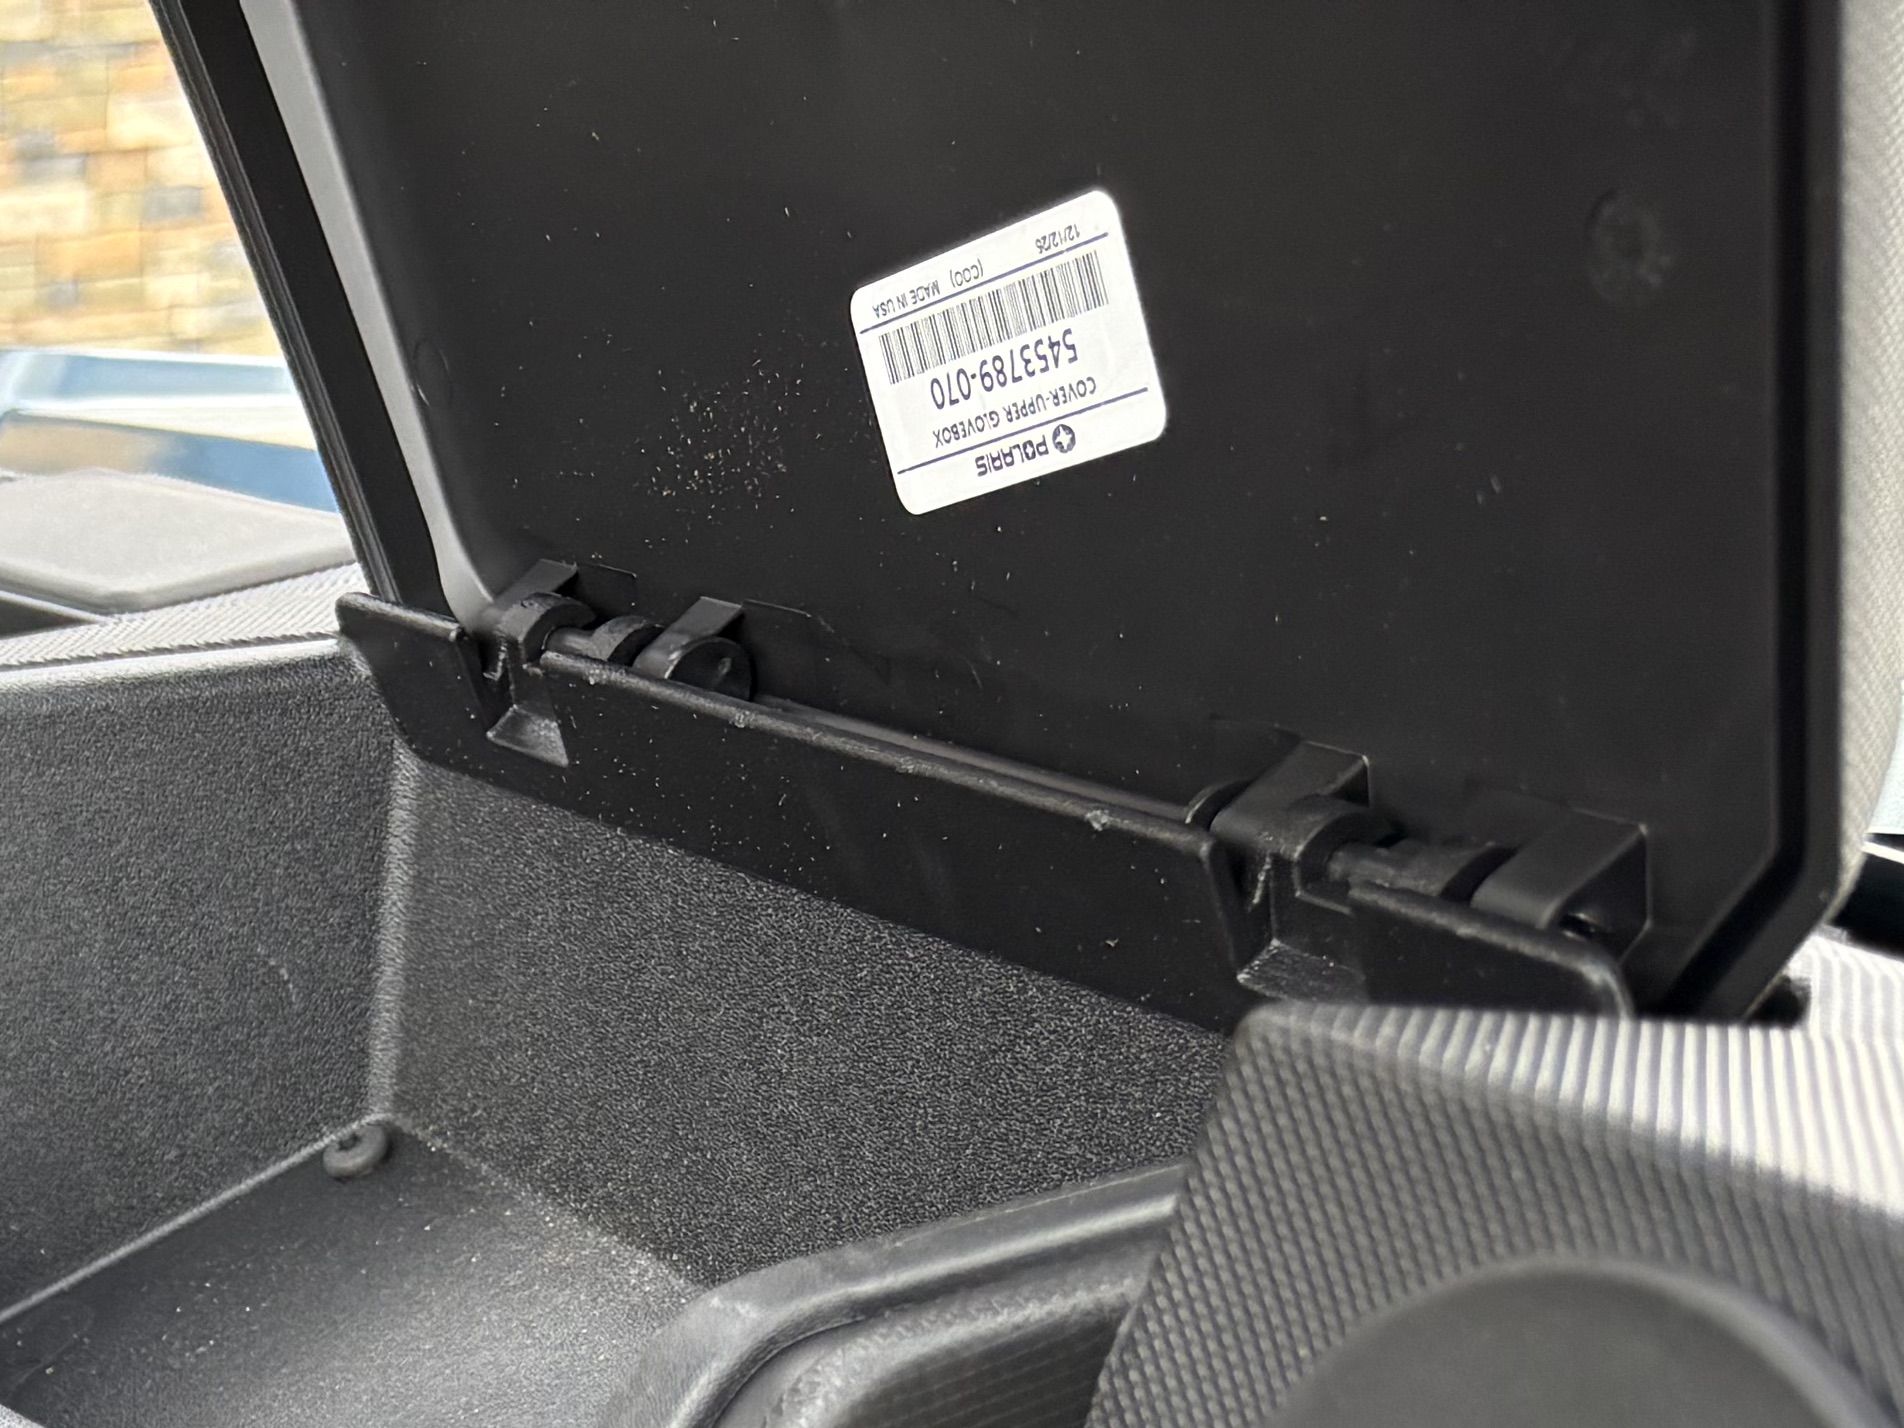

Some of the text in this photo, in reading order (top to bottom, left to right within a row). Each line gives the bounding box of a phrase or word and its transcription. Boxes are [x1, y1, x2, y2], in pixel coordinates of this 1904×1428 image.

[872, 259, 984, 318] (COO) MADE IN USA
[930, 328, 1078, 410] 5453789-070
[932, 376, 1096, 448] COVER-UPPER GLOVEBOX
[975, 435, 1049, 477] POLARIS
